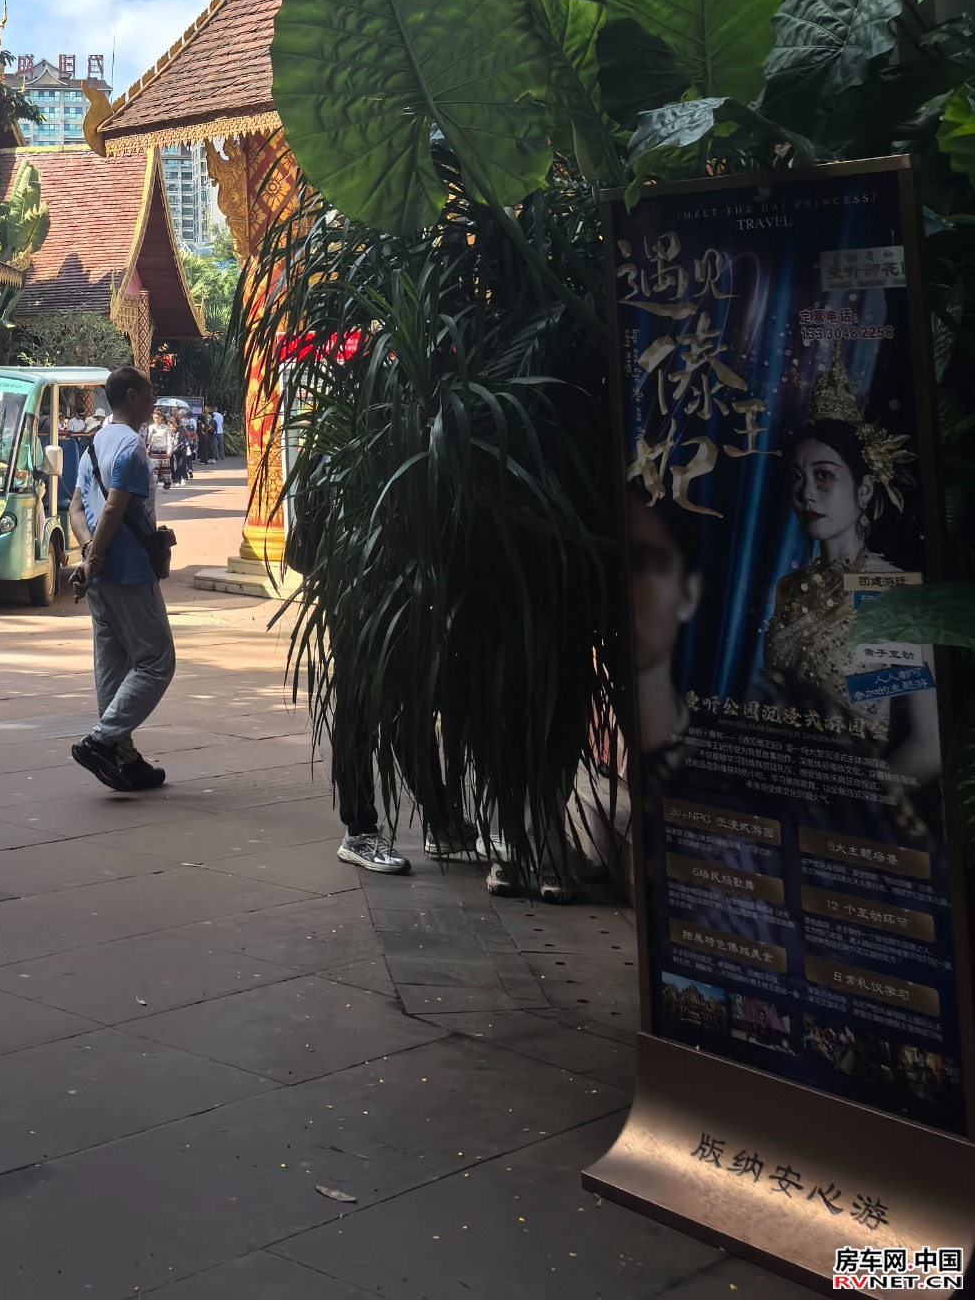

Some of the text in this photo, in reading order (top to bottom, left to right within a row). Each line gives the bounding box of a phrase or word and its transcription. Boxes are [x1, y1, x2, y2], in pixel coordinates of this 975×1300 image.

[725, 204, 754, 216] THE
[736, 216, 793, 231] TRAVEL
[800, 325, 894, 341] 133 3048 2258
[864, 648, 915, 660] 亲子互动
[874, 667, 922, 685] 人人都可
[685, 690, 890, 742] 曼听公园沉浸式游园会
[669, 806, 775, 839] 30+NPC 沉浸式游园
[827, 840, 899, 866] 8大主题场景
[692, 867, 756, 892] 6场民族歌舞
[826, 900, 910, 929] 12 个互动环节
[681, 928, 775, 964] 独具特色傣族美食
[833, 971, 911, 1001] 日常礼仪学习
[690, 1131, 891, 1232] 版纳安心游
